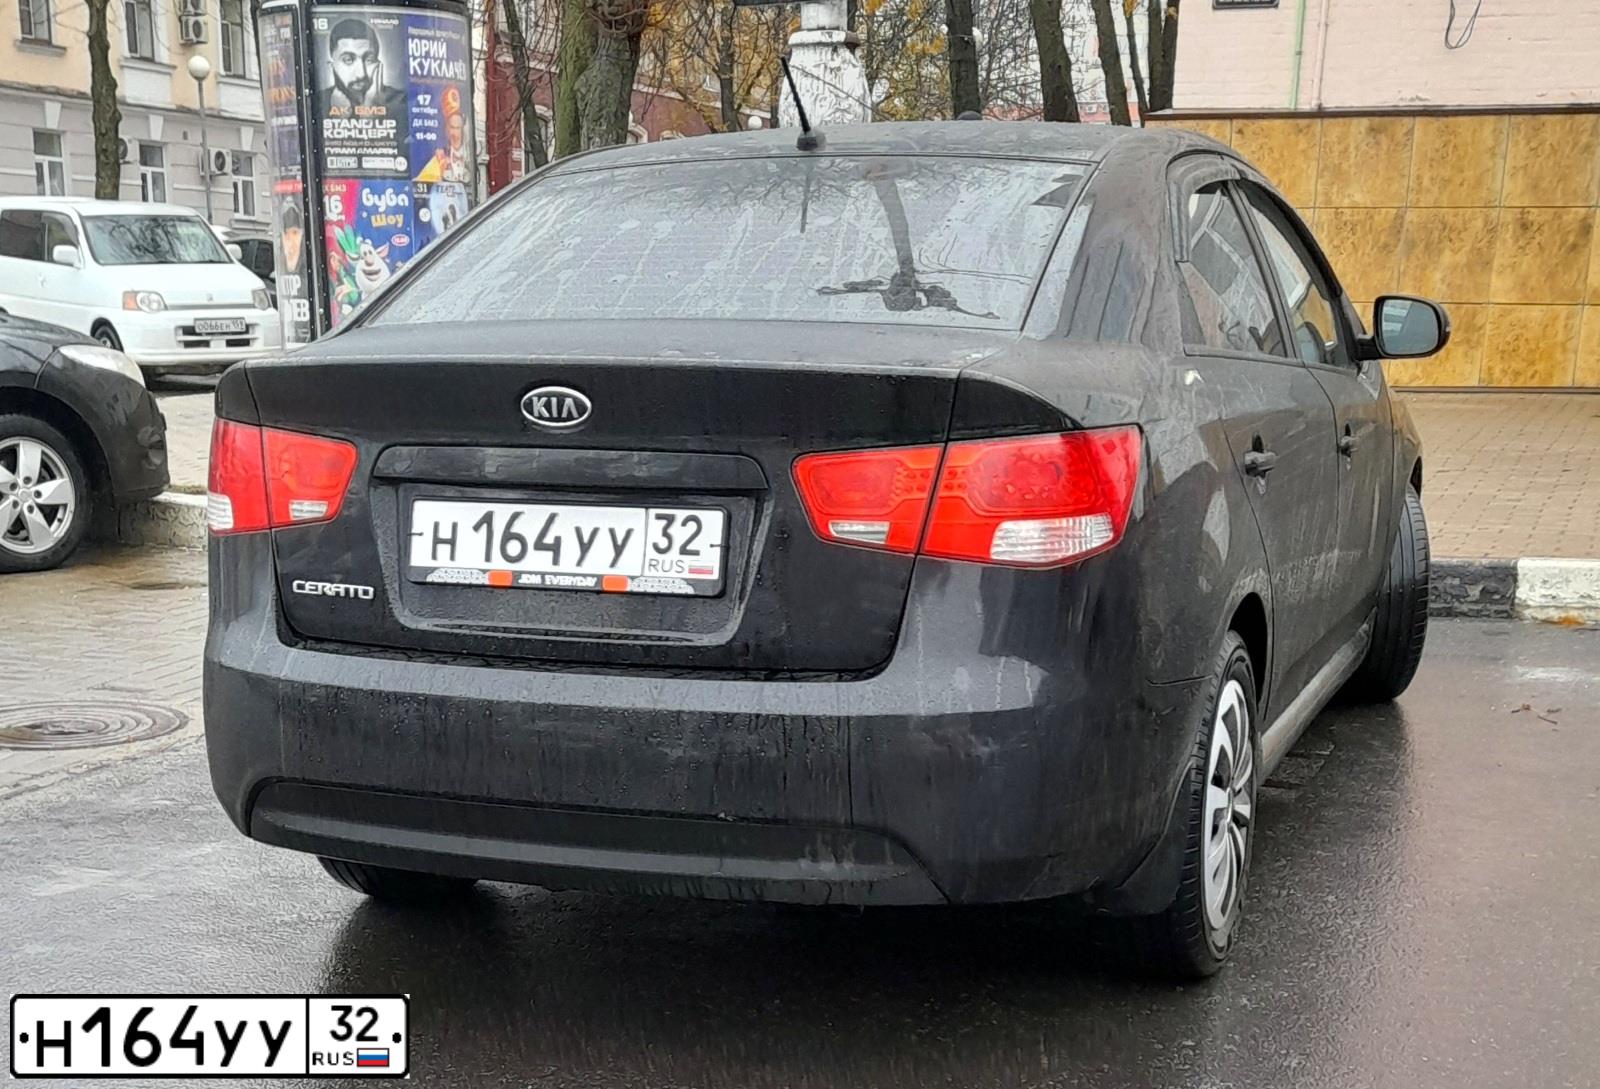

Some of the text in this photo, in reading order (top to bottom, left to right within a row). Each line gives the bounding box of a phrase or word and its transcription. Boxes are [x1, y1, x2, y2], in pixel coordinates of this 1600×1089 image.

[408, 38, 447, 59] ЮРИЙ
[417, 94, 431, 106] 17
[323, 119, 397, 129] STAND UP
[323, 128, 397, 140] КОНЦЕРТ
[532, 397, 579, 419] KIA
[652, 513, 703, 556] 32
[648, 558, 686, 575] RUS
[544, 574, 598, 587] EVERYDAY
[292, 580, 374, 600] CERATO
